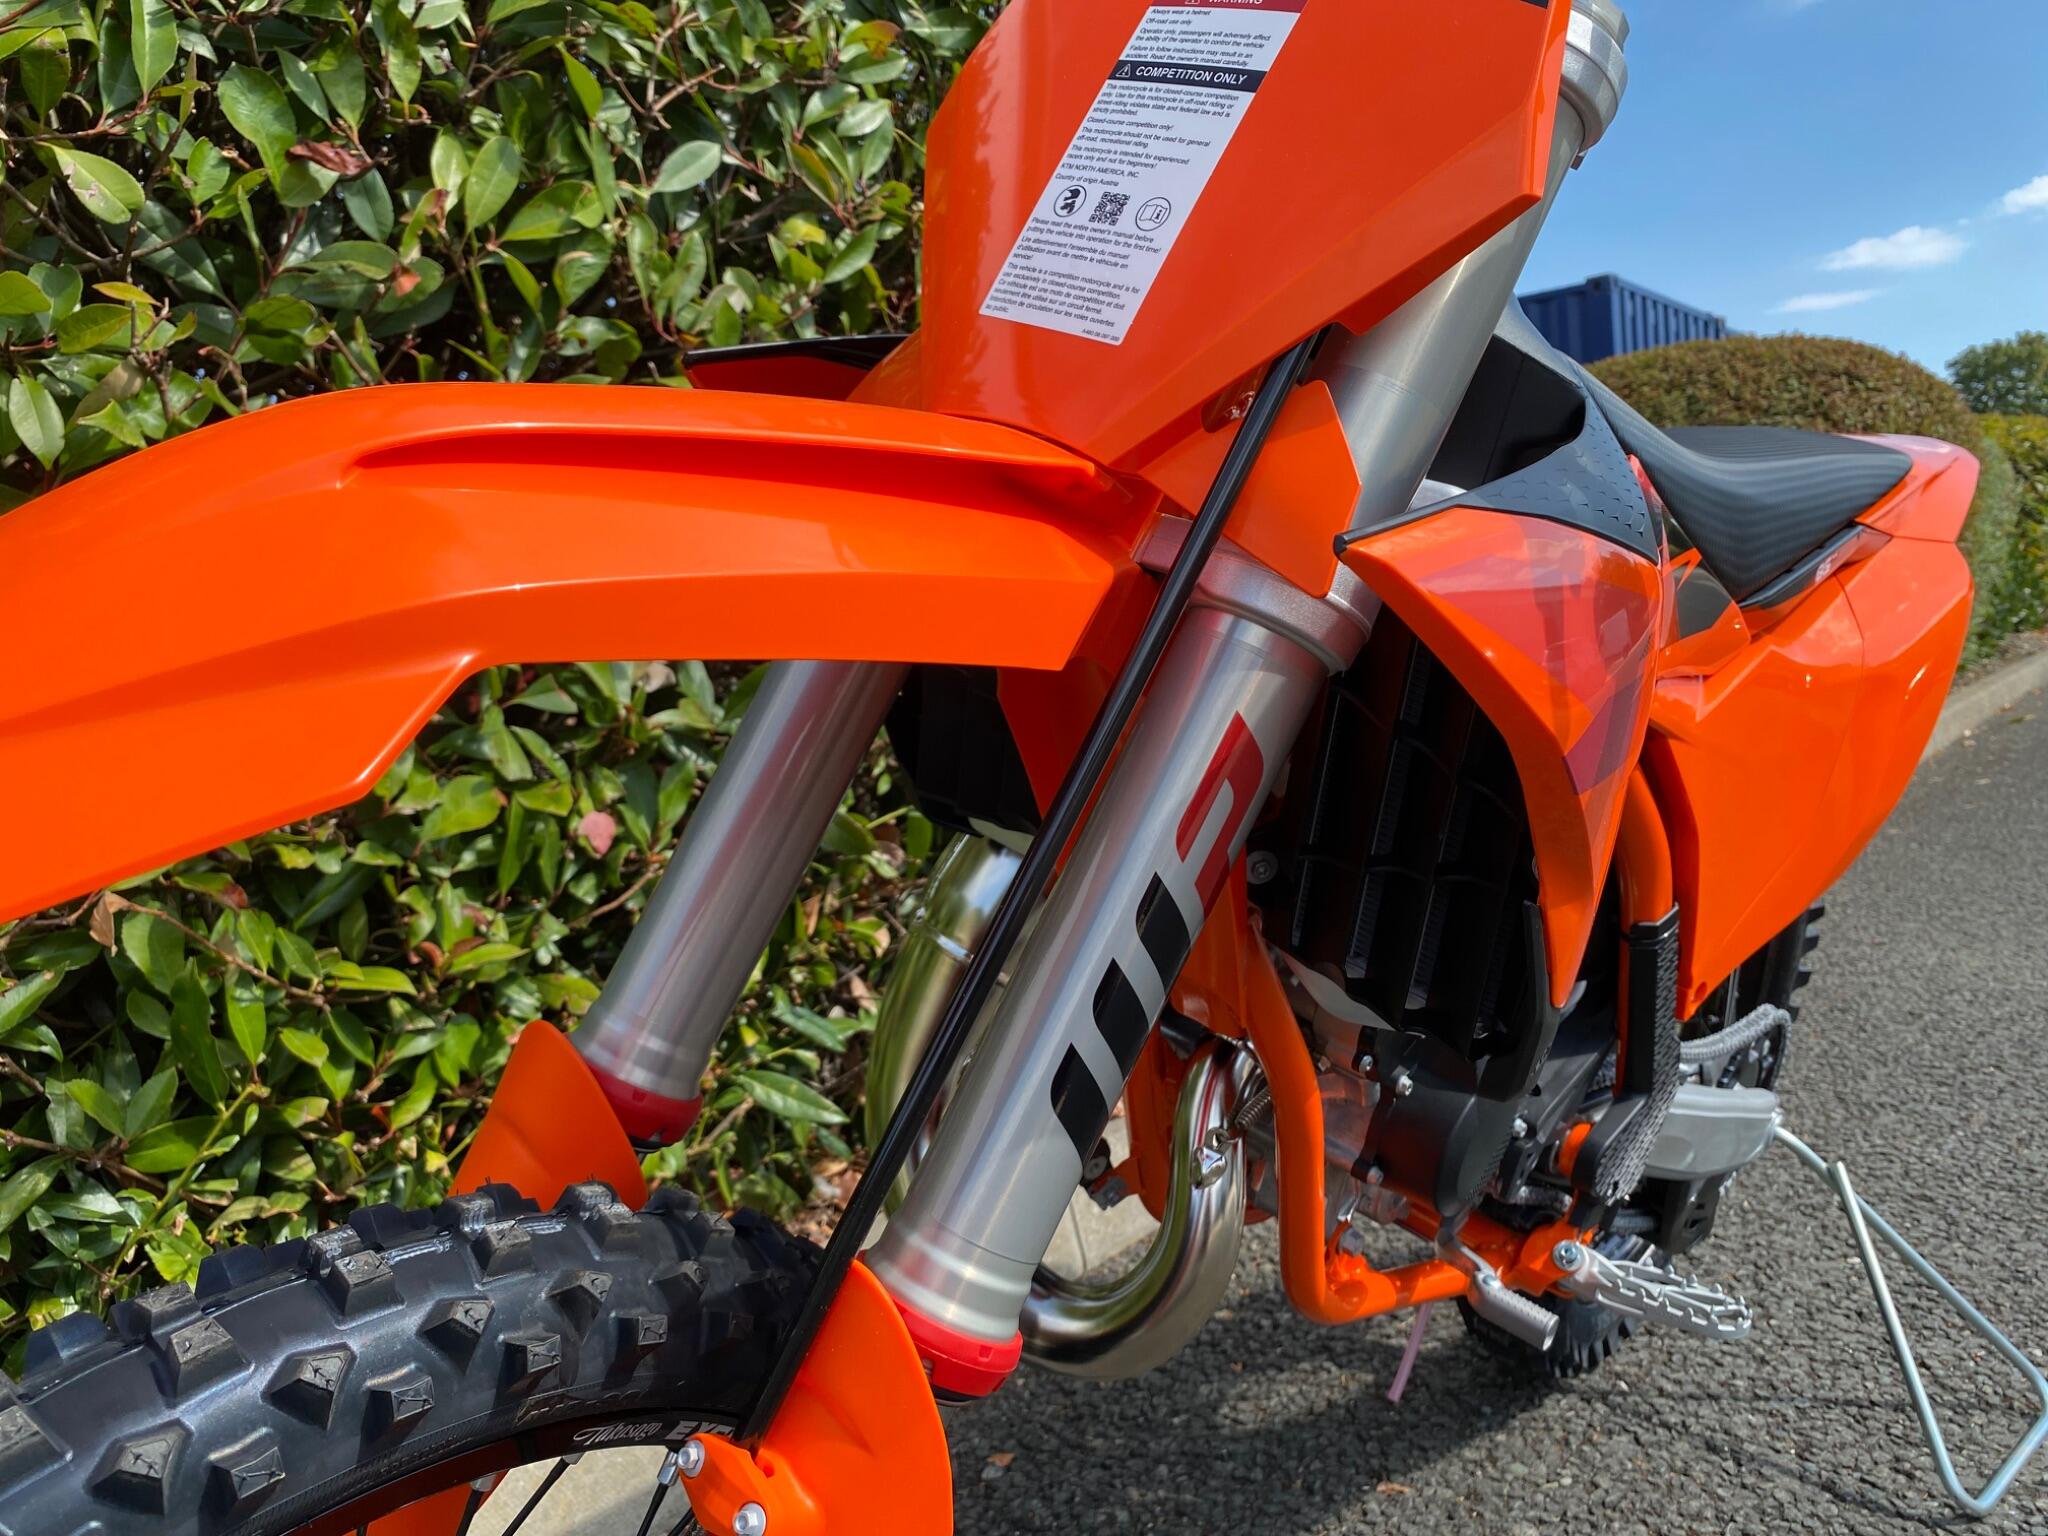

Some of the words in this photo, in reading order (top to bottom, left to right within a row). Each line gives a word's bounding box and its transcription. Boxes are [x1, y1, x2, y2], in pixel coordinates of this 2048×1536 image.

[1222, 32, 1252, 41] adversely
[1134, 66, 1213, 81] COMPETITION
[1212, 72, 1248, 84] ONLY
[1163, 88, 1204, 97] closed-course
[1097, 99, 1129, 108] street-riding
[1146, 96, 1178, 104] motorcycle
[1087, 116, 1125, 125] Closed-course
[1093, 128, 1123, 136] motorcycle
[1083, 146, 1113, 154] motorcycle
[1118, 150, 1144, 158] intended
[1152, 156, 1190, 164] experienced
[1074, 164, 1097, 172] NORTH
[1055, 173, 1076, 182] Country
[573, 1422, 663, 1446] Takasago
